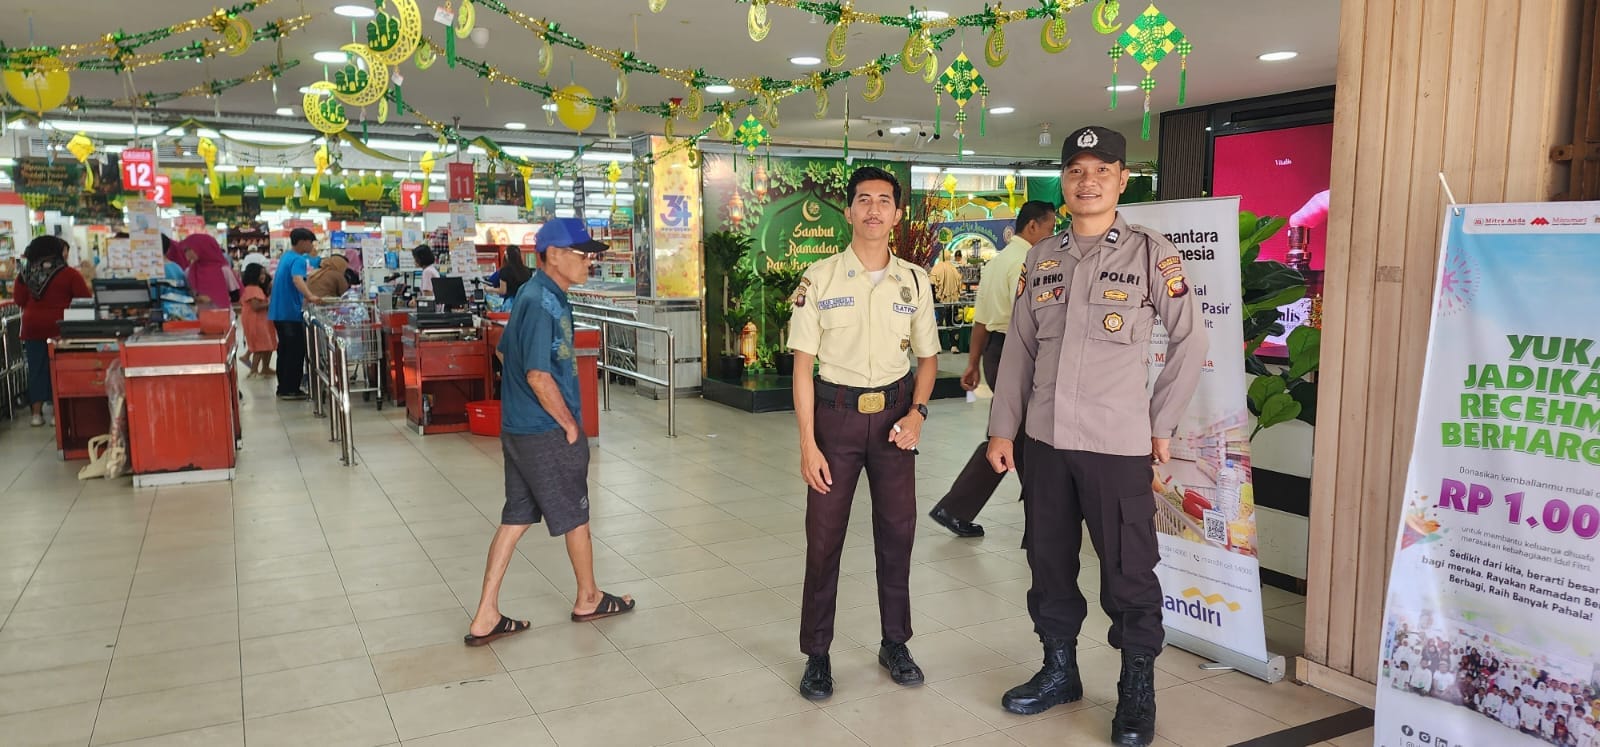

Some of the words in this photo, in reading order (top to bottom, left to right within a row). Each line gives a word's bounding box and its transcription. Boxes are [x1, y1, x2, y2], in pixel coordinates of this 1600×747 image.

[125, 163, 151, 187] 12
[153, 185, 165, 204] 2
[455, 176, 470, 195] 11
[409, 192, 417, 209] 1
[792, 222, 834, 238] Sambut
[1163, 229, 1218, 243] nantara
[784, 239, 839, 258] Ramadan
[1179, 246, 1214, 260] nesia
[1042, 273, 1063, 286] RENO
[1100, 271, 1140, 286] POLRI
[1194, 285, 1207, 296] ial
[1460, 466, 1500, 480] Donasikan
[1501, 473, 1564, 491] kembalianmu
[1565, 487, 1594, 497] mulai
[1438, 478, 1493, 515] RP
[1461, 527, 1482, 536] untuk
[1484, 532, 1523, 546] membantu
[1524, 540, 1562, 554] keluarga
[1563, 550, 1595, 561] dhuafa
[1461, 535, 1501, 550] merasakan
[1502, 545, 1552, 562] kebahagiaan
[1449, 549, 1480, 564] Sedikit
[1482, 558, 1502, 570] dari
[1504, 563, 1524, 577] kita,
[1526, 569, 1565, 586] berarti
[1567, 579, 1600, 595] besar
[1421, 554, 1445, 569] bagi
[1447, 562, 1484, 578] mereka.
[1486, 571, 1526, 591] Rayakan
[1529, 583, 1581, 604] Ramadan
[1584, 597, 1600, 610] Be
[1449, 574, 1486, 593] Berbagi,
[1489, 585, 1510, 598] Raih
[1512, 591, 1549, 608] Banyak
[1551, 602, 1594, 621] Pahala!
[1162, 595, 1221, 627] andiri
